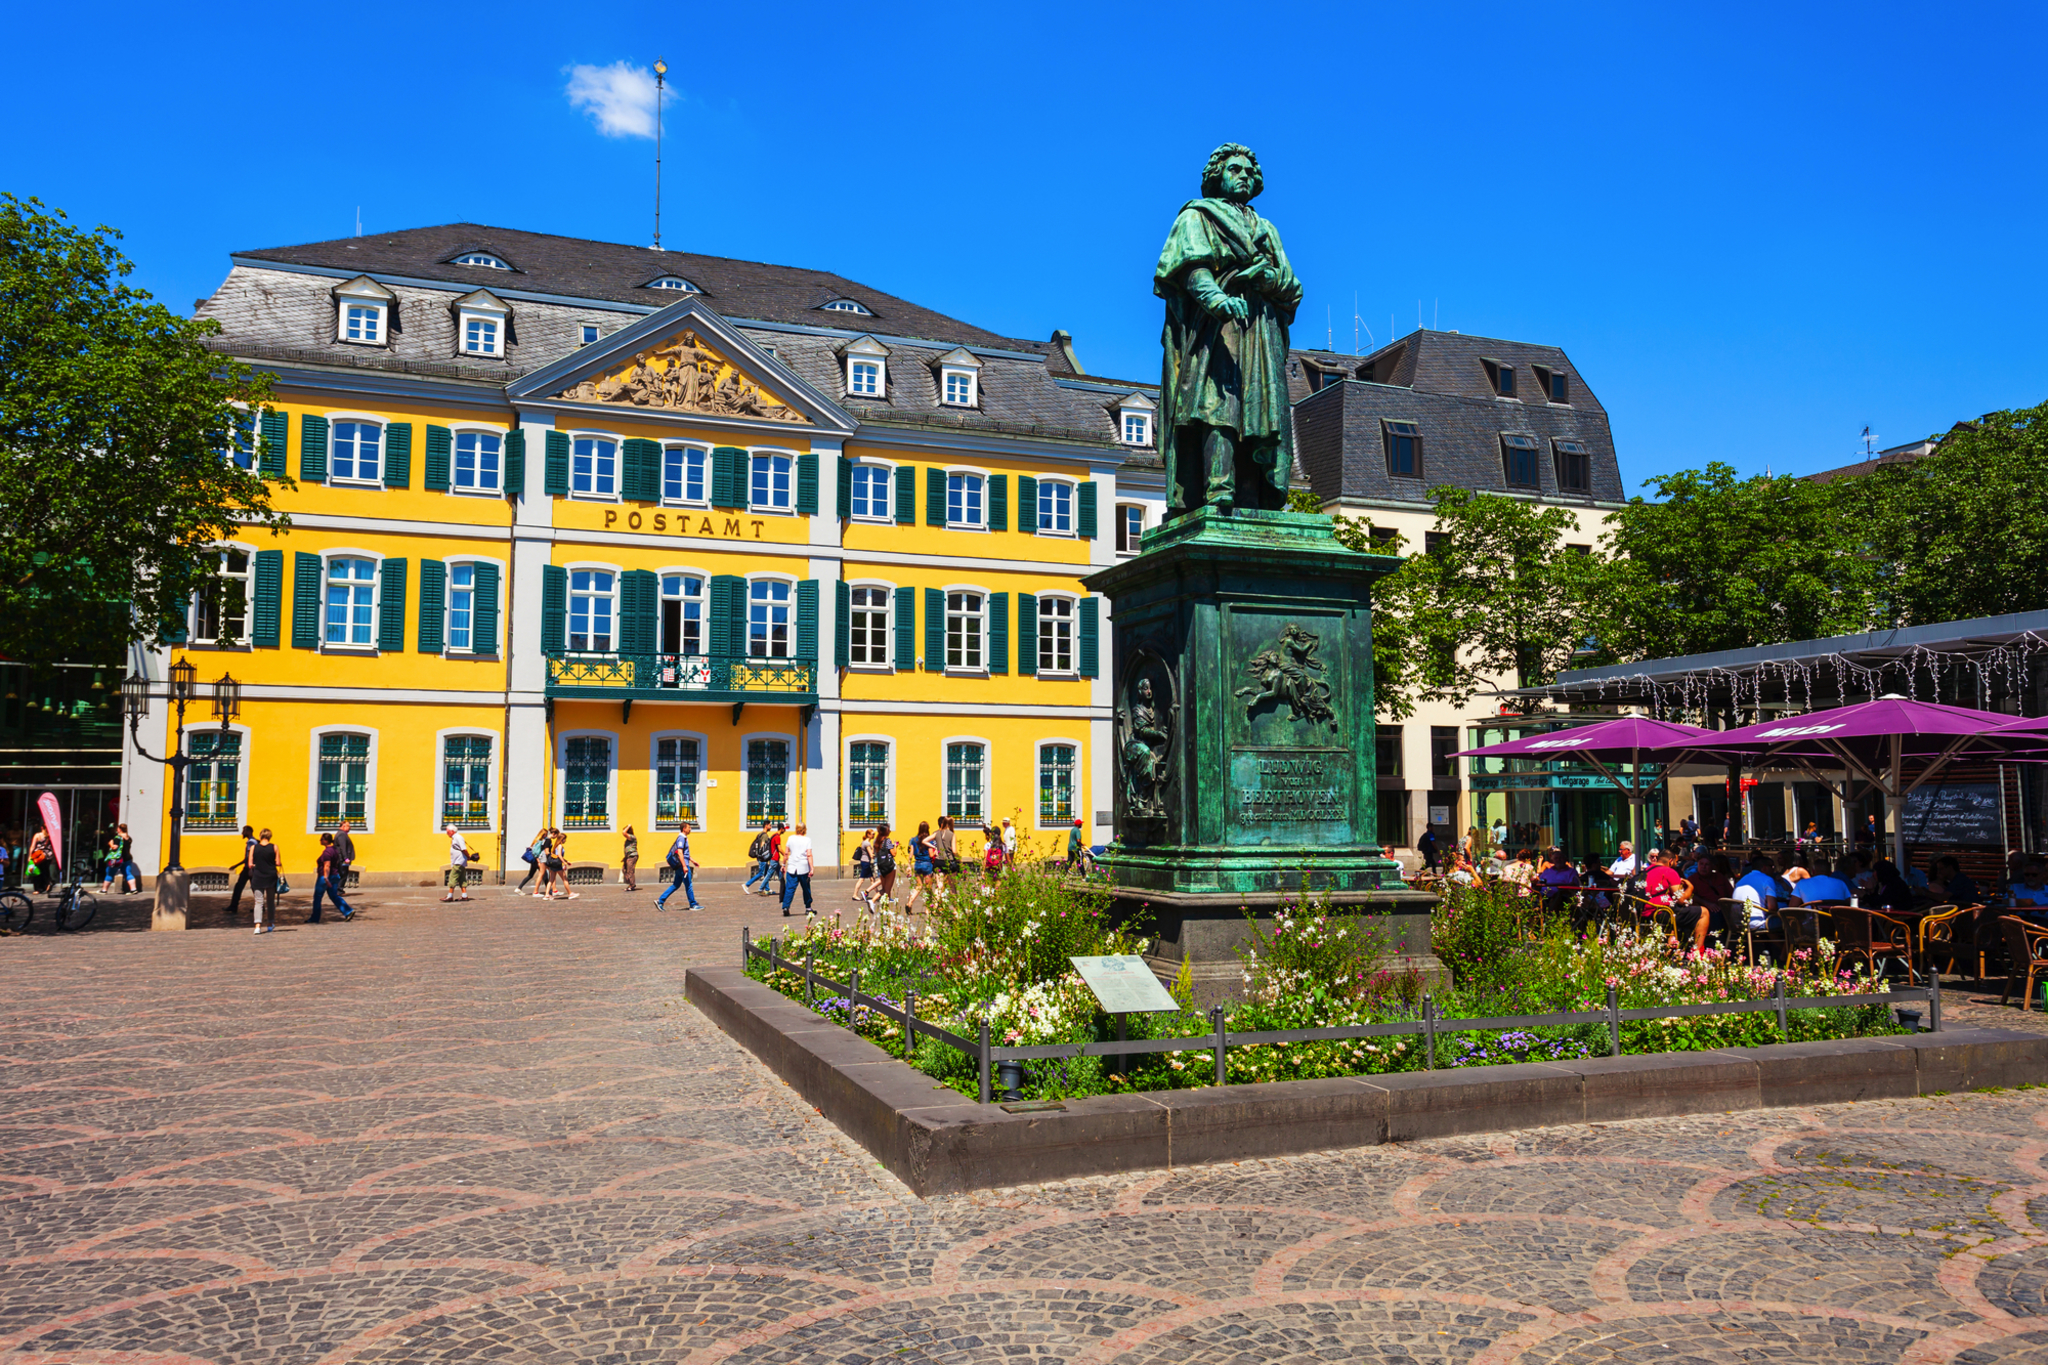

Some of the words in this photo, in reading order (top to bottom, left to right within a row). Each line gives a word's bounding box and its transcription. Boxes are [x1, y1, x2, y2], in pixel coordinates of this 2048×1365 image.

[604, 510, 764, 538] POSTAMT
[1754, 723, 1847, 738] MIDI
[1524, 738, 1593, 749] MIDI
[1259, 759, 1323, 775] LUDWIG
[1520, 776, 1548, 788] Tiefgarage
[1557, 776, 1589, 787] Tiefgarage
